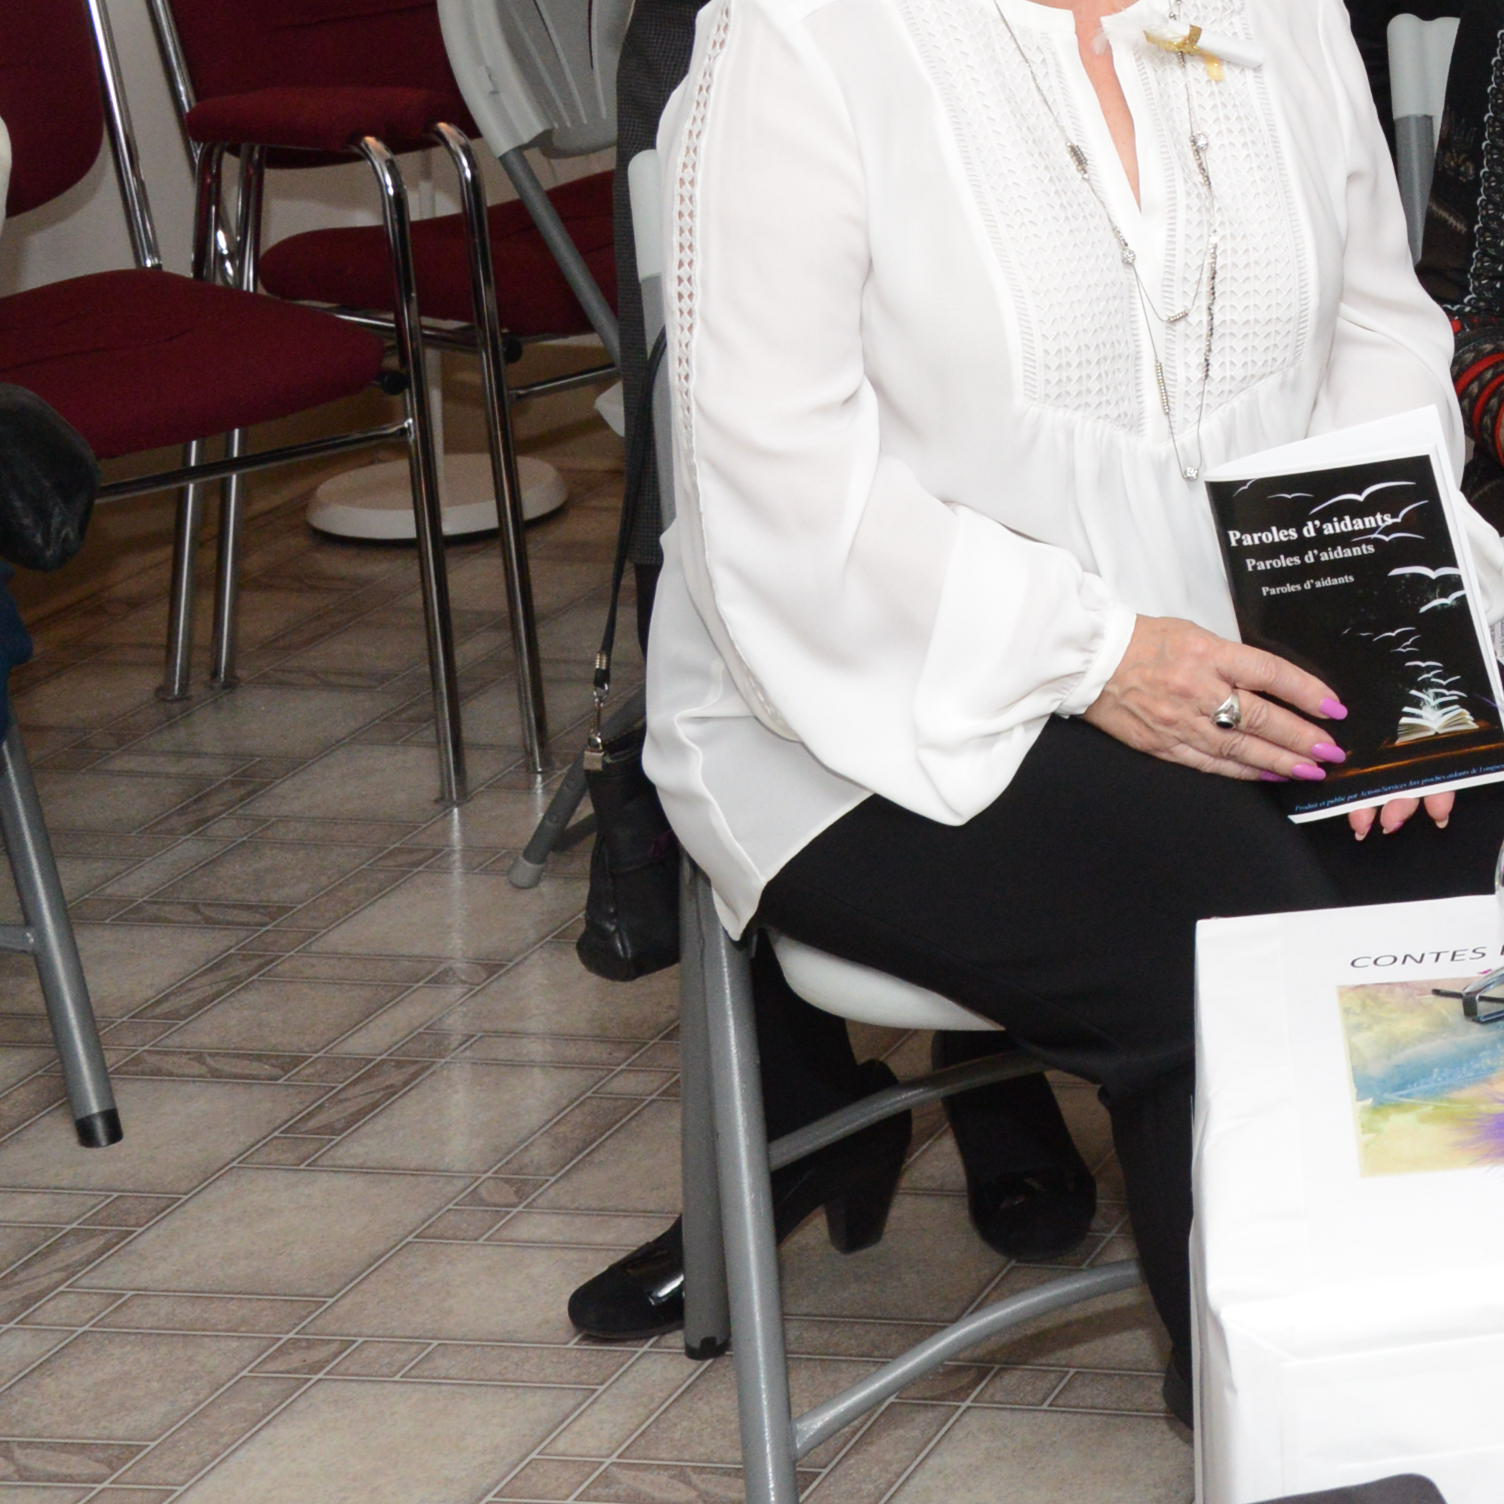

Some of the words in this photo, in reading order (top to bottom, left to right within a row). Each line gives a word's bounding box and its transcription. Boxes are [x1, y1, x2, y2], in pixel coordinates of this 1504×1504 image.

[1227, 526, 1299, 547] Paroles
[1302, 511, 1392, 539] d'aidants
[1245, 555, 1302, 573] Paroles
[1304, 542, 1376, 564] d'aidants
[1261, 582, 1302, 596] Paroles
[1304, 573, 1355, 591] d'aidants
[1350, 946, 1487, 969] CONTES
